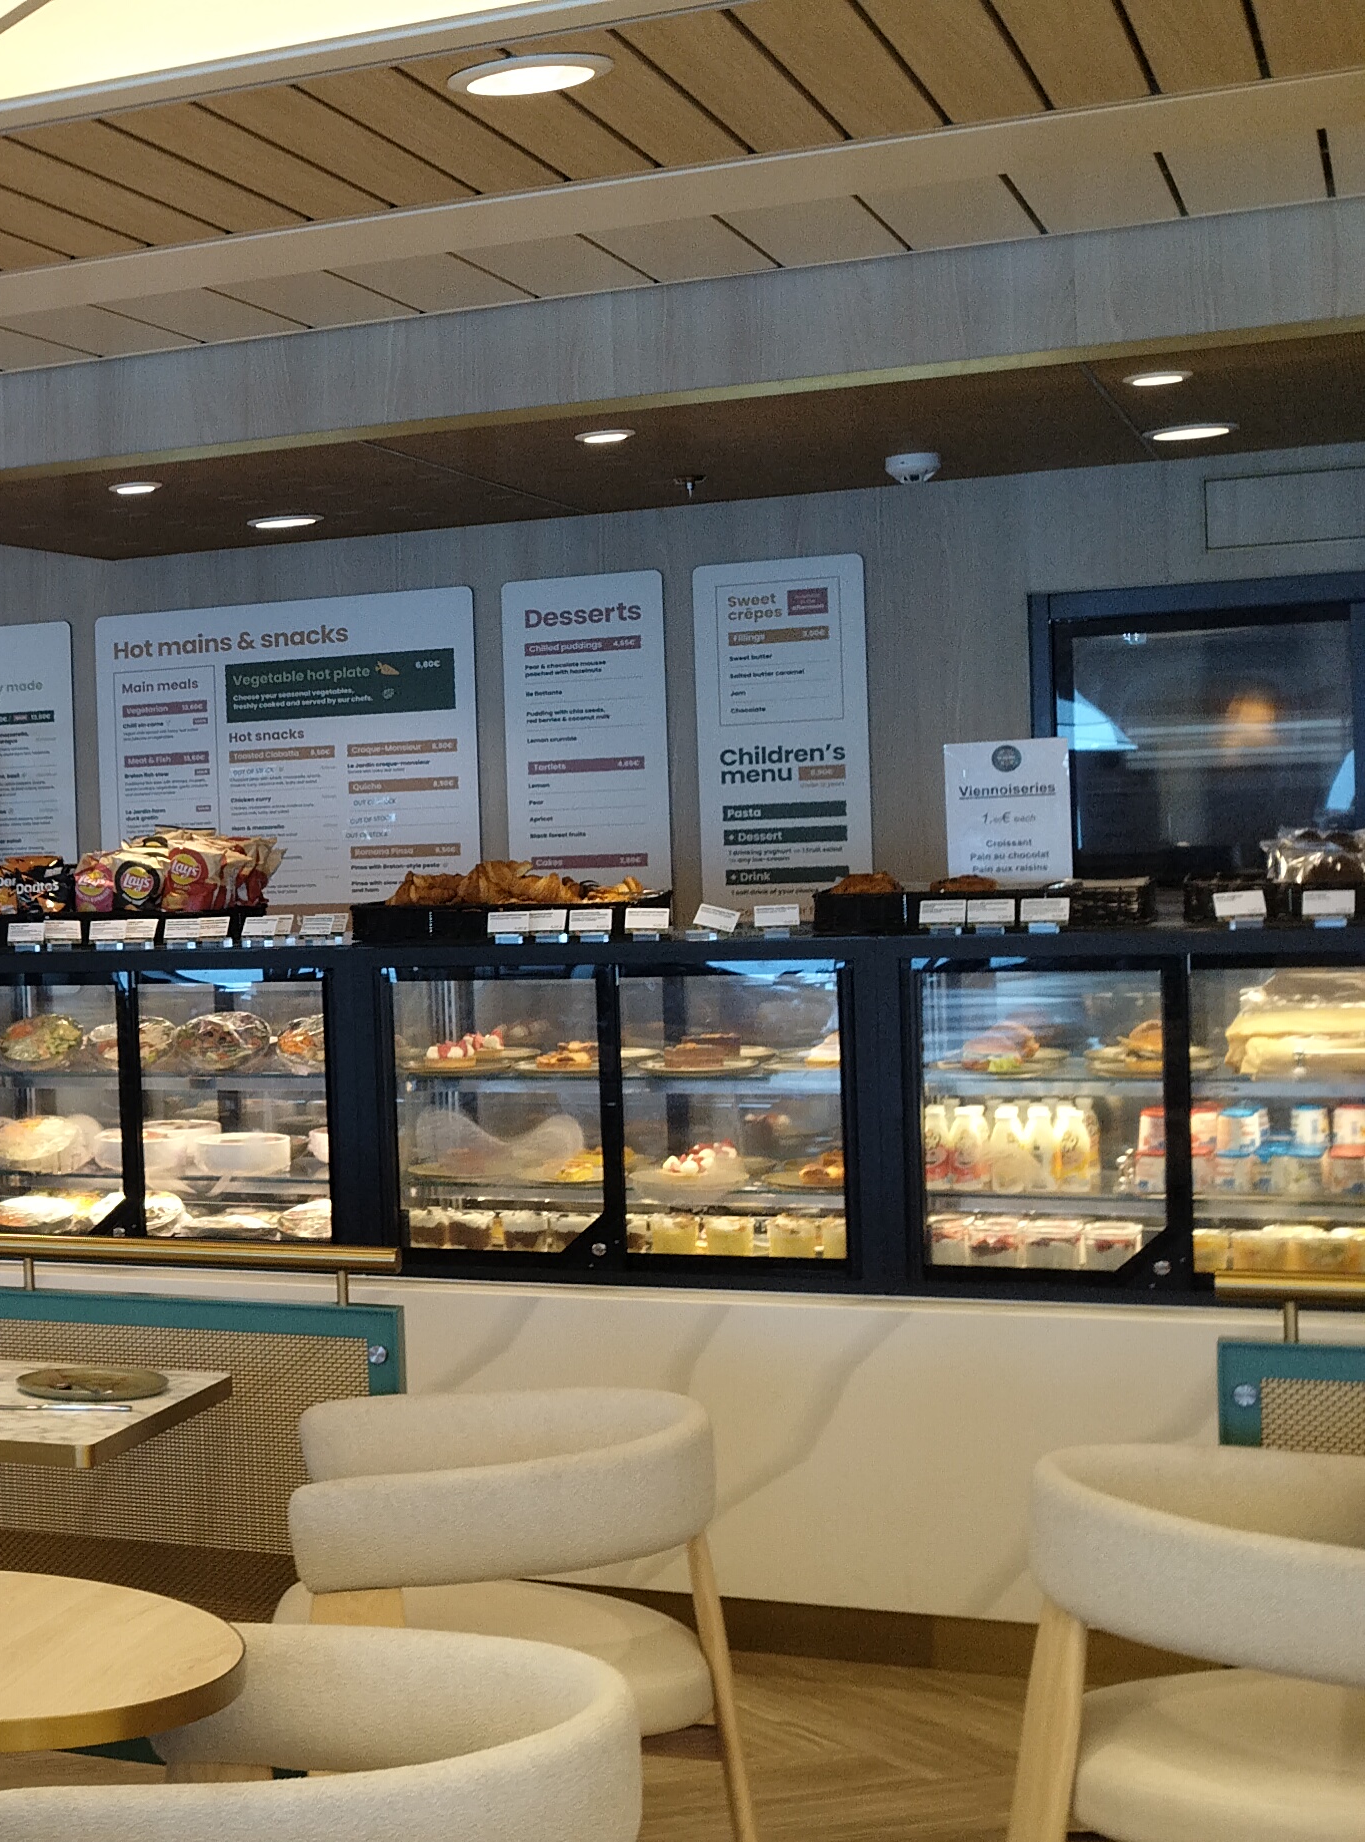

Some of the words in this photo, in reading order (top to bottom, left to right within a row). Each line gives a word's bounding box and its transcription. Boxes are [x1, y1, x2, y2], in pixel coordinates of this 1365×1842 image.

[728, 593, 776, 607] Sweet
[524, 602, 642, 629] Desserts
[728, 607, 782, 623] crêpes
[113, 640, 153, 660] Hot
[158, 634, 232, 656] mains
[237, 631, 256, 651] &
[260, 624, 349, 648] snacks
[529, 643, 559, 653] Chilled
[561, 641, 603, 653] puddings
[232, 670, 305, 689] Vegetable
[306, 668, 331, 681] hot
[333, 665, 371, 683] plate
[6, 680, 43, 692] made
[121, 681, 154, 694] Main
[157, 678, 199, 691] meals
[232, 694, 260, 702] Choose
[261, 692, 277, 701] your
[278, 689, 311, 698] seasonal
[312, 687, 355, 697] vegetables,
[126, 705, 169, 715] Vegetarian
[233, 701, 258, 711] freshly
[258, 699, 285, 709] cooked
[286, 698, 301, 707] and
[301, 697, 326, 706] served
[326, 697, 336, 706] by
[730, 706, 766, 714] Chocolate
[228, 731, 253, 743] Hot
[255, 728, 305, 742] snacks
[234, 751, 264, 761] Toasted
[265, 749, 300, 759] Ciabatta
[351, 743, 422, 755] Croque-Monsieur
[719, 743, 846, 766] Children's
[127, 757, 147, 765] Meat
[533, 763, 567, 771] Tartlets
[720, 767, 793, 785] menu
[352, 782, 382, 791] Quiche
[959, 783, 1056, 799] Viennoiseries
[727, 808, 762, 818] Pasta
[738, 831, 783, 842] Dessert
[985, 838, 1032, 848] Croissant
[970, 852, 992, 862] Pain
[994, 852, 1006, 860] au
[1008, 850, 1050, 860] chocolat
[535, 858, 563, 867] Cakes
[972, 865, 993, 874] Pain
[1015, 864, 1048, 872] raisins
[739, 871, 771, 882] Drink
[16, 879, 60, 895] Doritos
